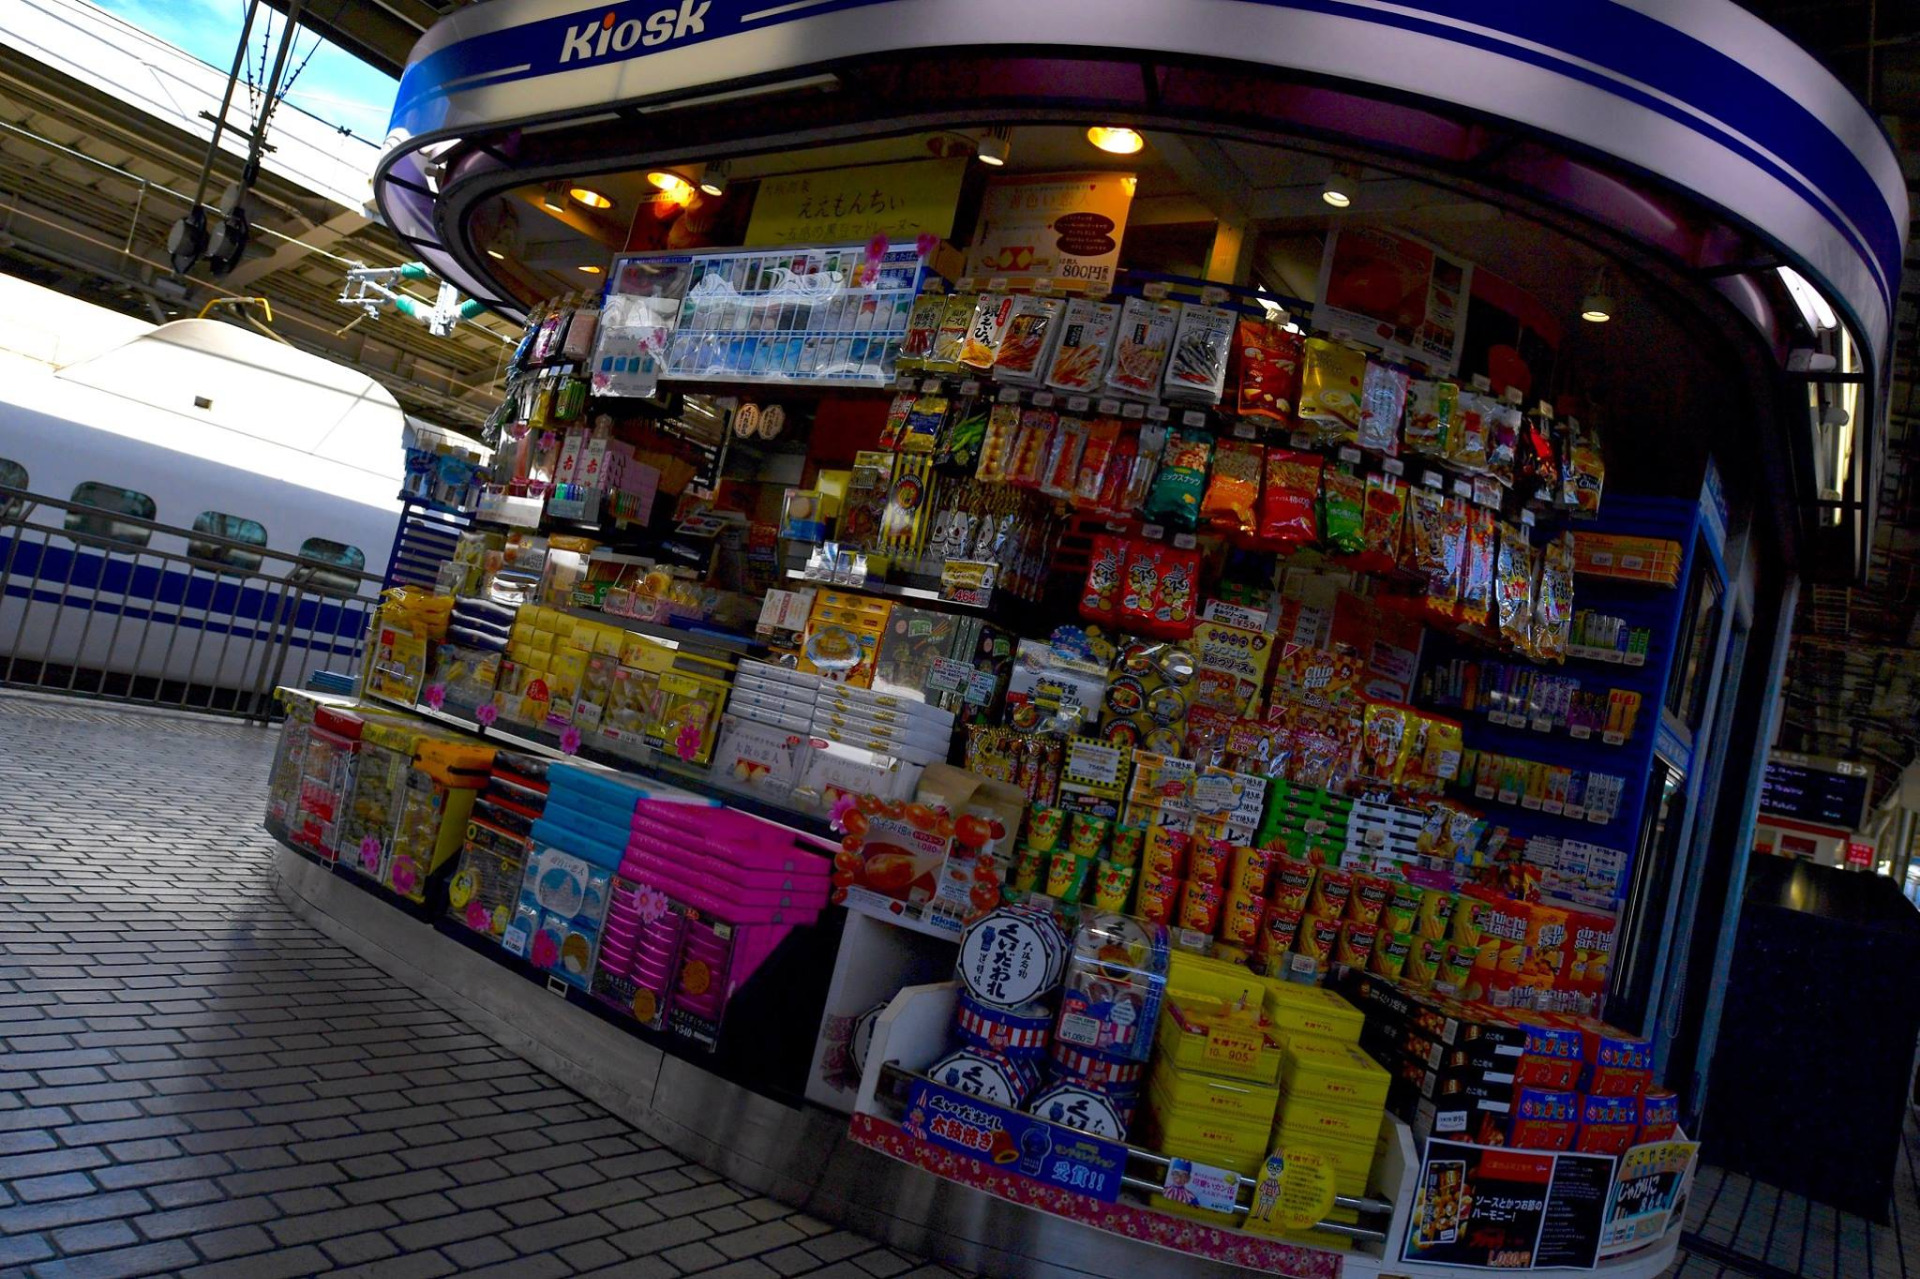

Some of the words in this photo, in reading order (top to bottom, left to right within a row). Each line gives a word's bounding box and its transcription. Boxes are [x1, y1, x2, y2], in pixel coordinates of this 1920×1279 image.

[558, 0, 713, 64] Kiosk
[1062, 264, 1102, 280] 800円
[1231, 743, 1248, 753] 389
[986, 923, 1020, 1000] くいだおれ
[1017, 941, 1034, 980] 大阪名物
[929, 1095, 1004, 1131] くいだおれ
[929, 1114, 994, 1153] 太鼓焼き
[1475, 1194, 1544, 1212] ソースとかつお節の
